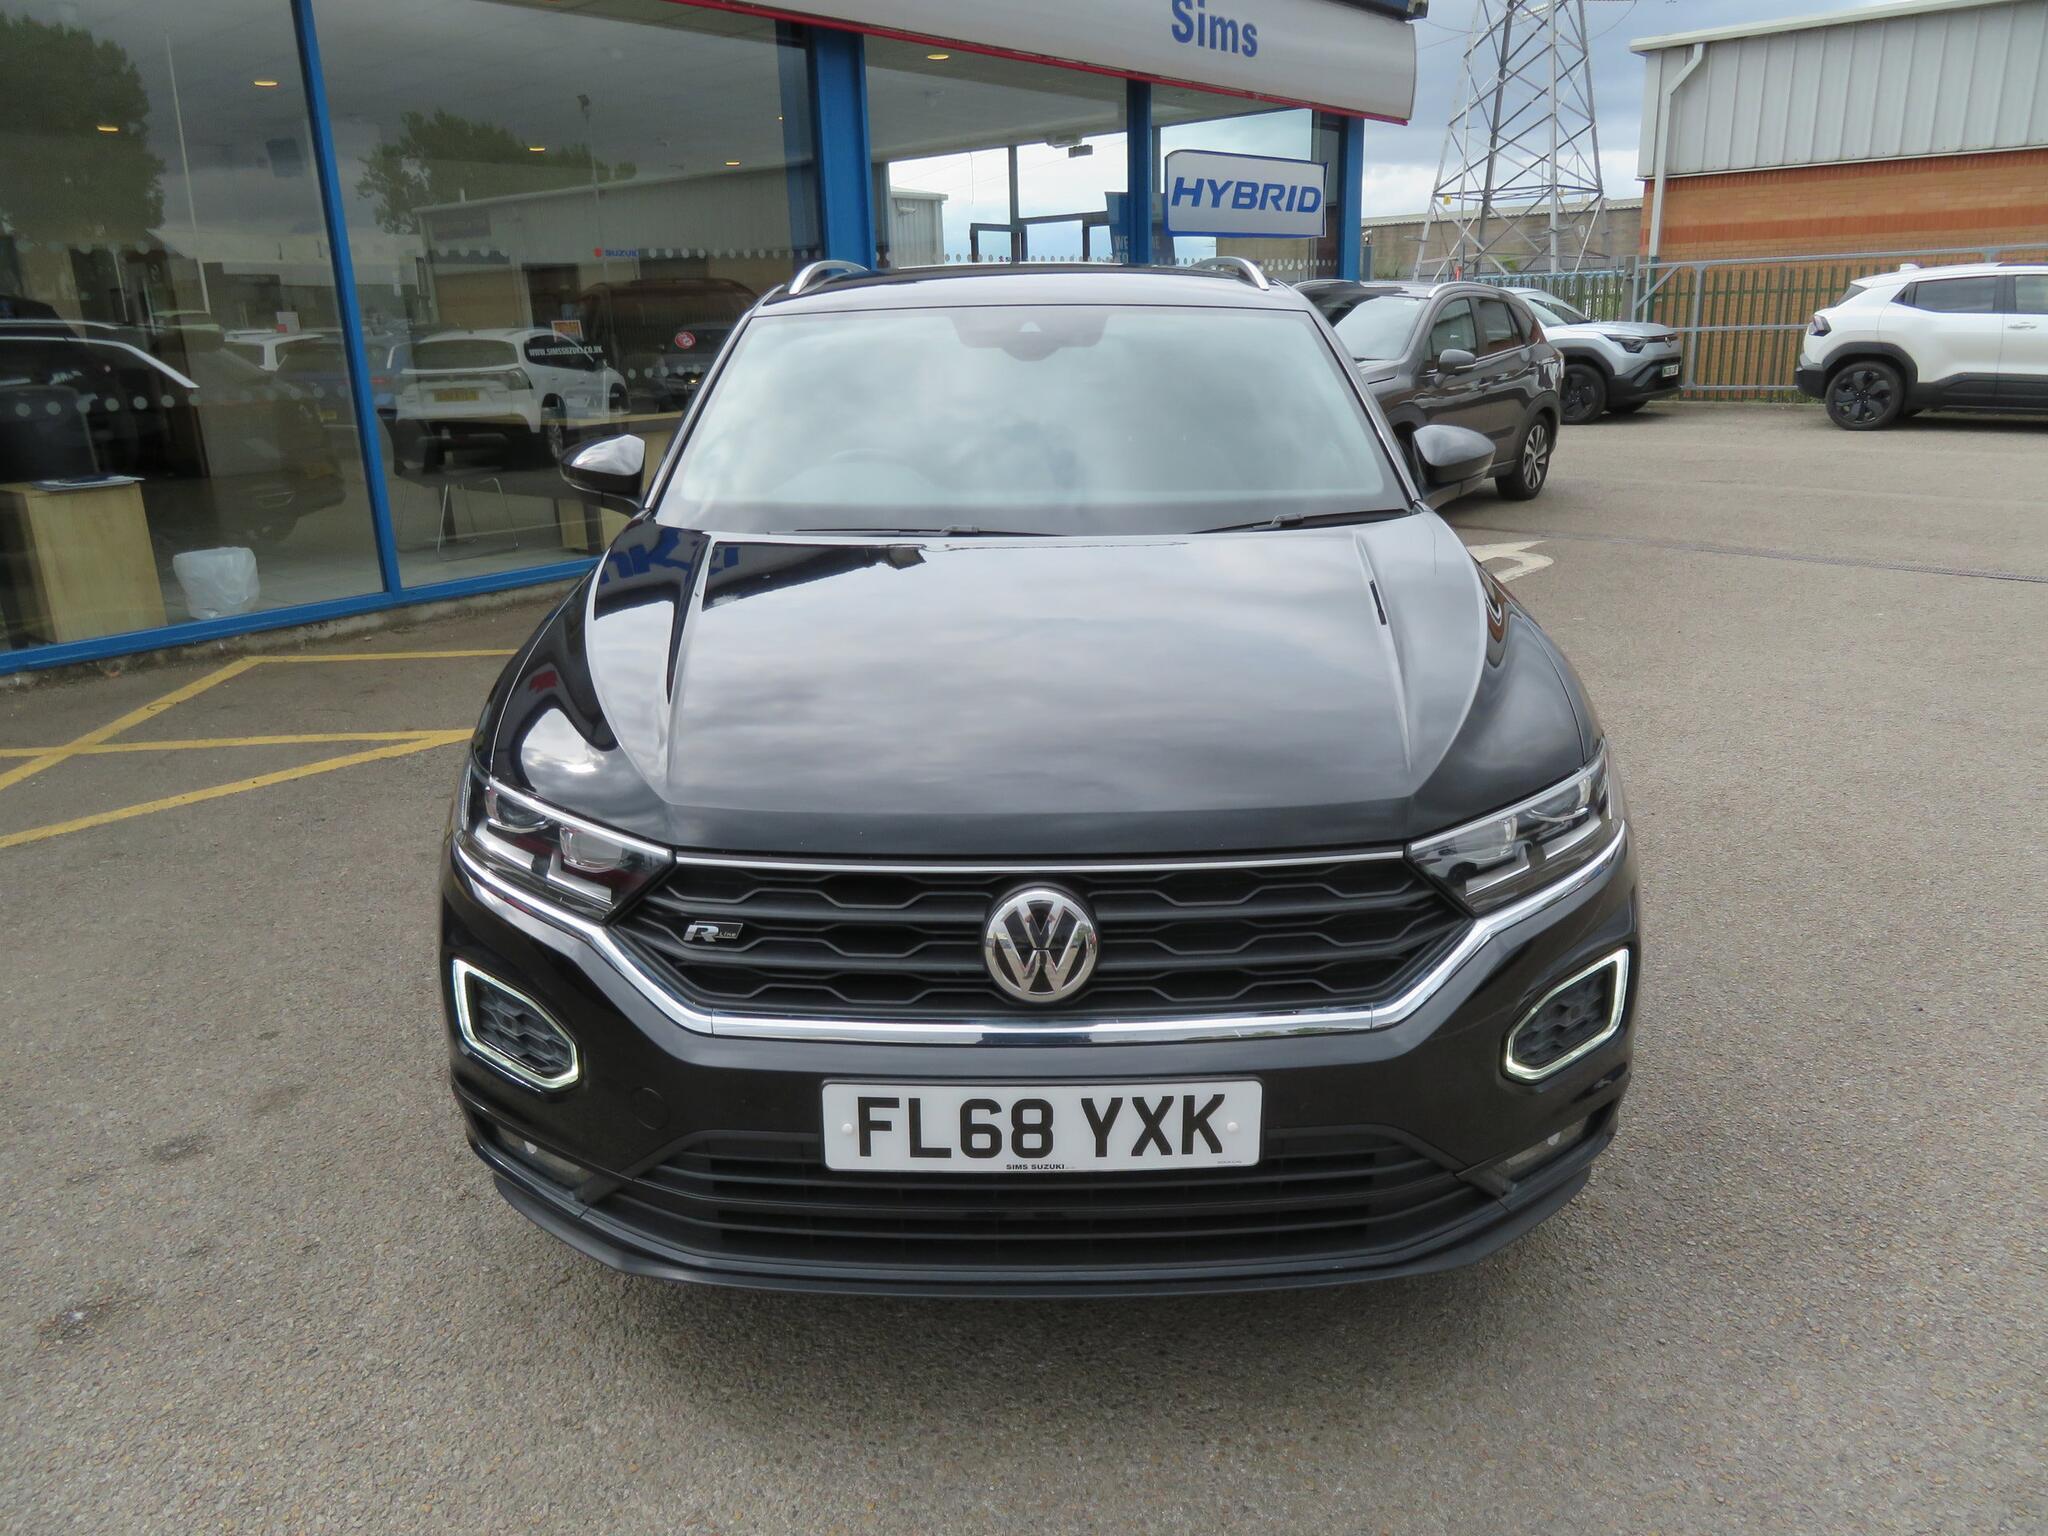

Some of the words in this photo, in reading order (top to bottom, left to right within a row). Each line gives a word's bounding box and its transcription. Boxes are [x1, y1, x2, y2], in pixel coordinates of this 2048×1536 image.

[1171, 0, 1258, 58] Sims
[1171, 177, 1322, 213] HYBRID
[857, 1096, 1054, 1160] FL68
[1080, 1094, 1226, 1158] YXK
